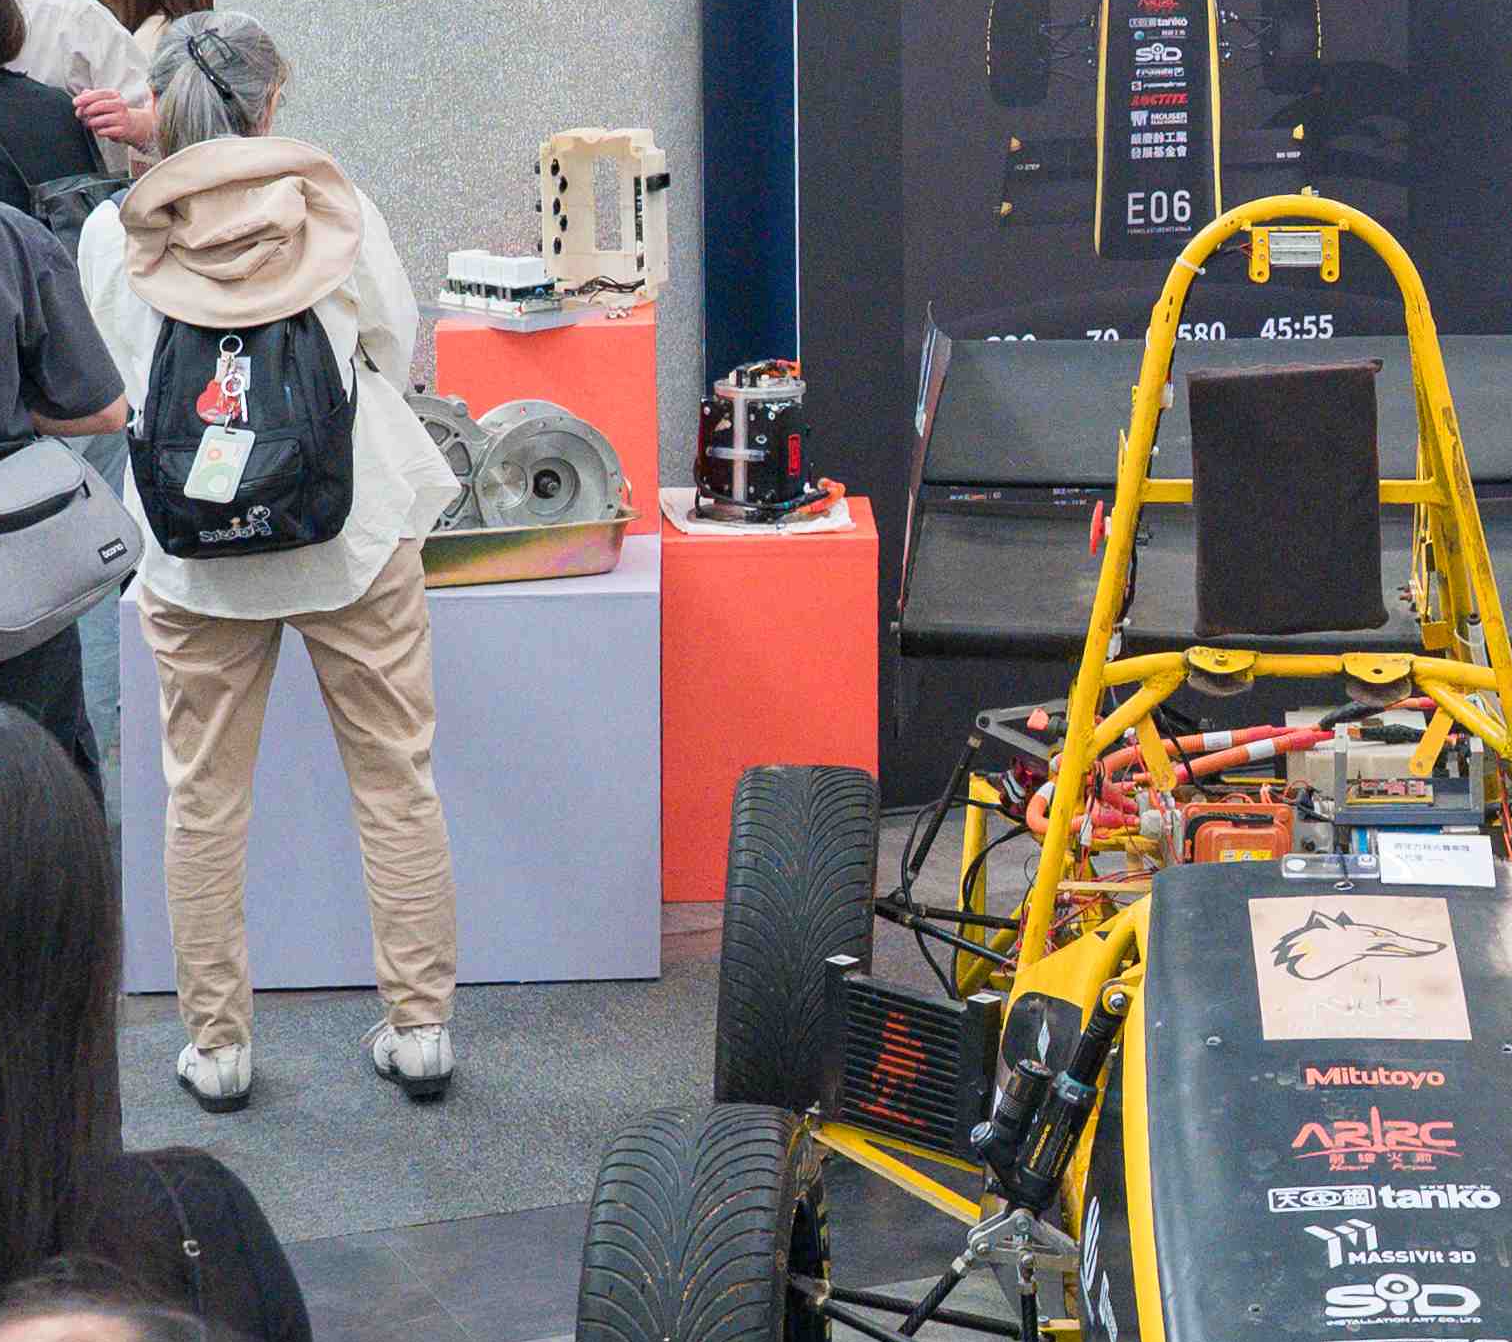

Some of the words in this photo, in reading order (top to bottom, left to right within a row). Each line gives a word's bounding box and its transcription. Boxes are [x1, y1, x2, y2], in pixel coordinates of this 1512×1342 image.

[1127, 190, 1192, 225] E06
[1304, 1066, 1445, 1090] Mitutoyo
[1379, 1183, 1502, 1210] tanko
[1348, 1249, 1444, 1265] MASSIVit
[1448, 1250, 1476, 1264] 3D
